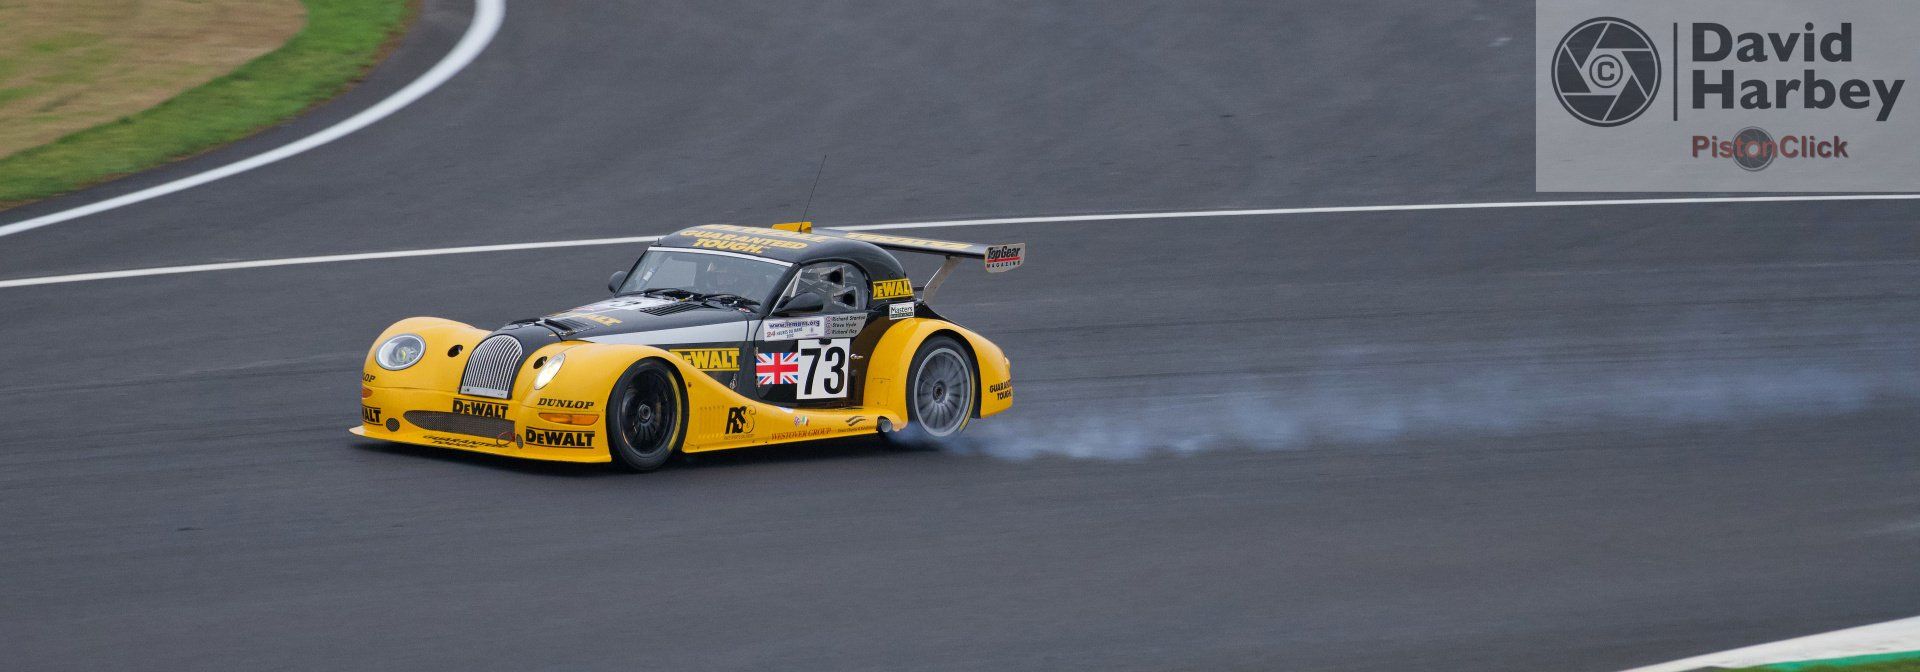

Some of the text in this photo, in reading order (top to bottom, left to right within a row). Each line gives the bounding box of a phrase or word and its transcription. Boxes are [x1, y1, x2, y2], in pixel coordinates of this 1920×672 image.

[680, 230, 808, 249] GUARANTEED
[987, 260, 1020, 268] MAGAZINE
[891, 306, 912, 314] Masters
[800, 346, 847, 395] 73
[537, 398, 594, 409] DUNLOP
[807, 427, 832, 437] GROUP
